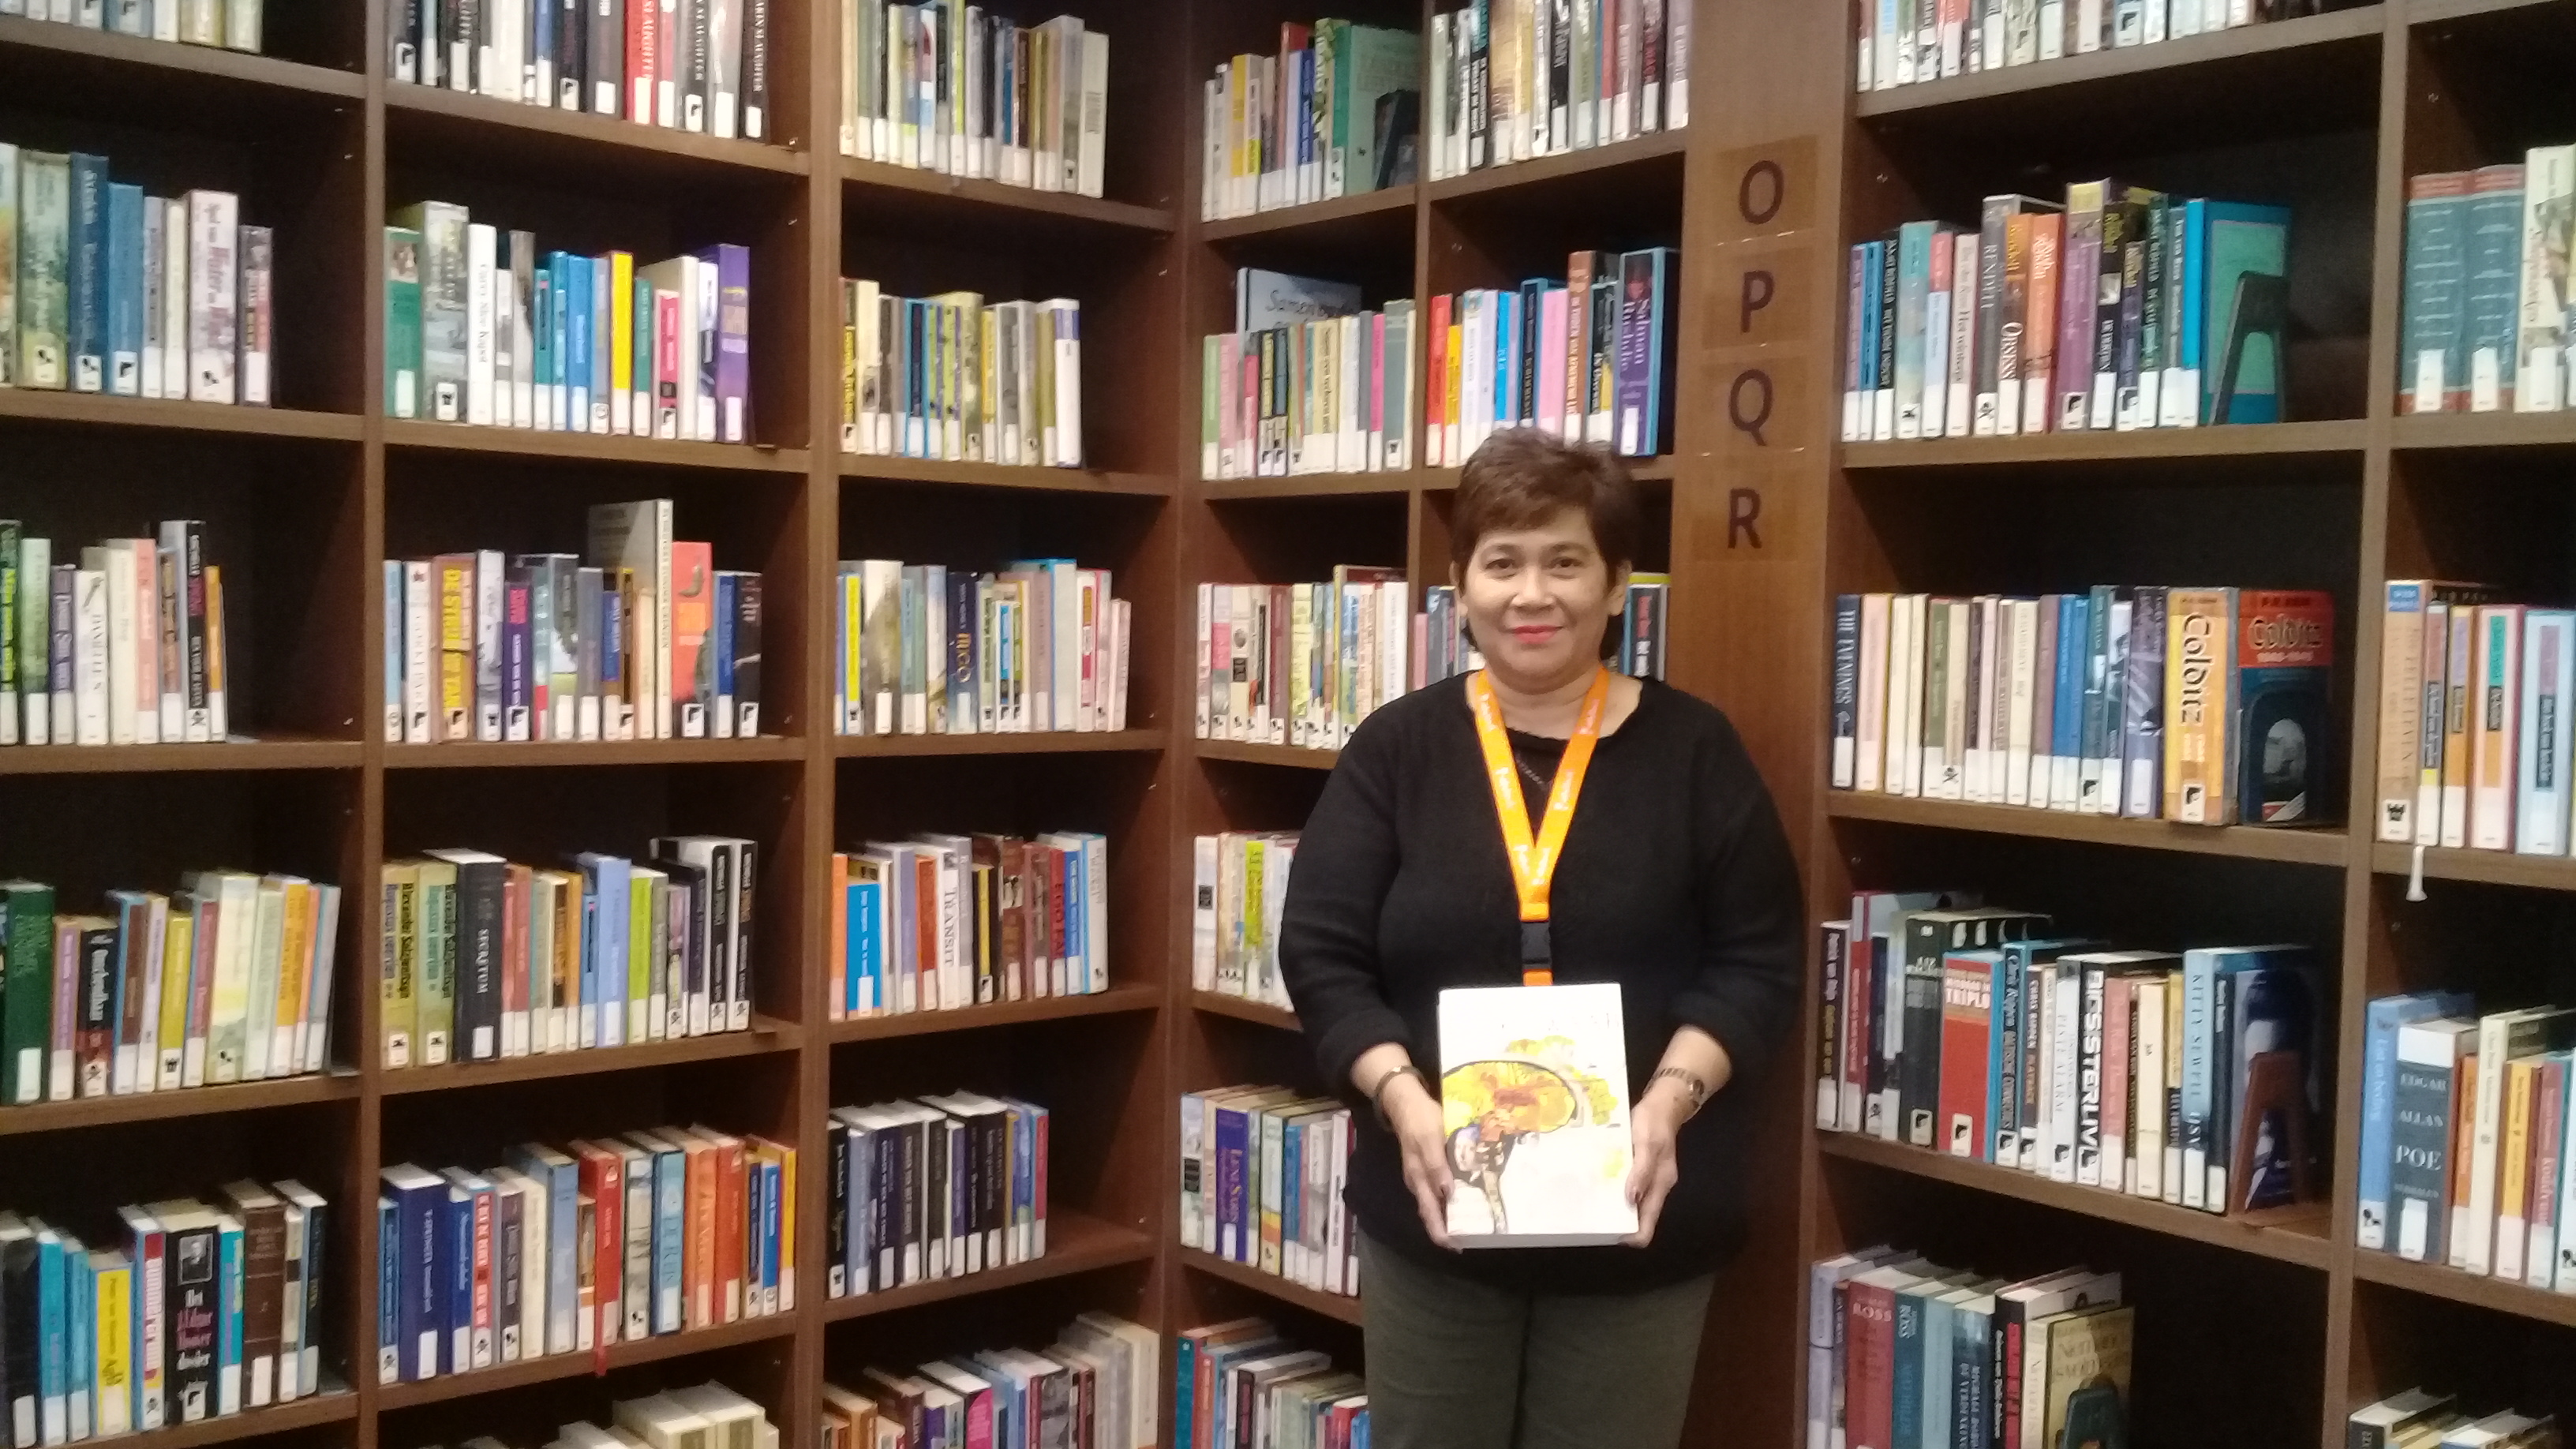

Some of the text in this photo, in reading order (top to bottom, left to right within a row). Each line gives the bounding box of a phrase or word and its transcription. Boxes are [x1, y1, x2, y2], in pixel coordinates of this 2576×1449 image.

[1739, 160, 1784, 225] O
[1740, 270, 1775, 333] P
[1980, 243, 2001, 310] RENDELL
[1999, 320, 2025, 380] OBSESS
[1728, 369, 1773, 446] Q
[1727, 488, 1762, 549] R
[1834, 638, 1855, 705] EVENINGS
[2181, 613, 2214, 726] Colditz
[943, 886, 957, 967] TRANSIT
[475, 927, 490, 994] SECRETUM
[2192, 974, 2205, 1025] KITTY
[2079, 969, 2105, 1147] BIGSISTERLIV
[2400, 1073, 2447, 1092] EDGAR
[2398, 1110, 2444, 1128] ALLAN
[2395, 1144, 2442, 1171] POE
[1852, 1301, 1893, 1322] ROSS
